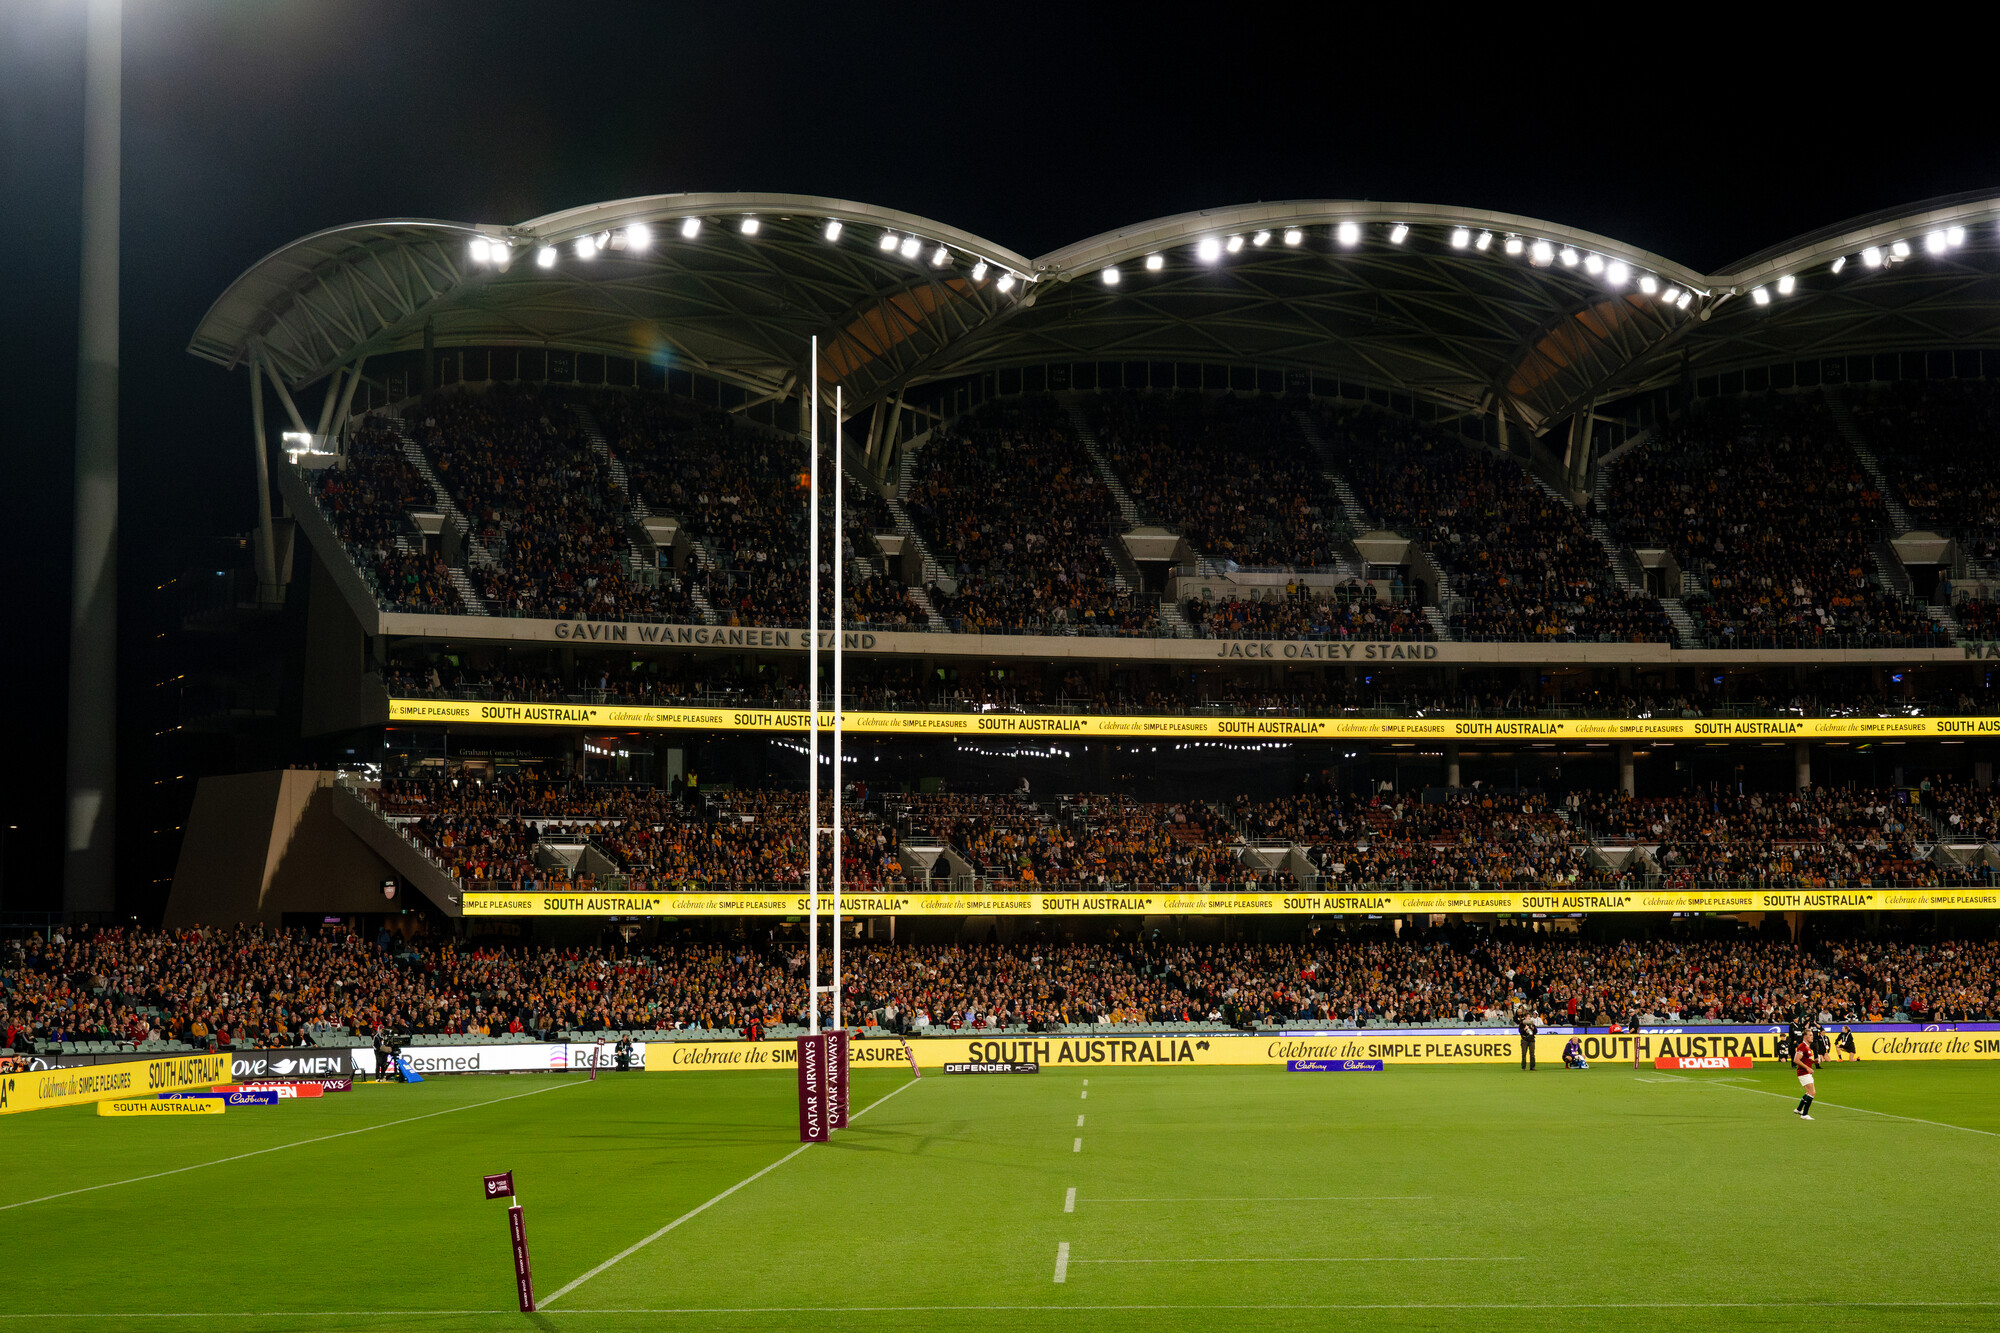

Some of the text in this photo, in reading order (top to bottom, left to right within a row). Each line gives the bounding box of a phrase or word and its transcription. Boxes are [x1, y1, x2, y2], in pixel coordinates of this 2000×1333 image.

[554, 622, 627, 641] GAVIN
[638, 625, 790, 647] WANGANEEN
[1217, 642, 1438, 660] JACK OATEY STAND
[400, 706, 426, 715] SIMPLE
[428, 707, 470, 716] PLEASURES
[482, 706, 589, 721] SOUTH AUSTRALIA
[609, 711, 723, 723] Celebrate the SIMPLE PLEASURES
[735, 713, 772, 726] SOUTH
[857, 717, 968, 728] Celebrate the SIMPLE PLEASURES
[978, 718, 1080, 731] SOUTH AUSTRALIA
[1099, 721, 1208, 731] Celebrate the SIMPLE PLEASURES
[1218, 721, 1318, 733] SOUTH AUSTRALIA
[1336, 723, 1445, 733] Celebrate the SIMPLE PLEASURES
[1456, 723, 1557, 734] SOUTH AUSTRALIA
[1575, 724, 1684, 733] Celebrate the SIMPLE PLEASURES
[1694, 722, 1796, 734] SOUTH AUSTRALIA
[1815, 723, 1848, 732] Celebrate
[1848, 722, 1860, 732] the
[1886, 723, 1926, 731] PLEASURES
[1937, 721, 1975, 732] SOUTH
[463, 900, 532, 909] SIMPLE PLEASURES
[544, 898, 652, 911] SOUTH AUSTRALIA
[672, 899, 787, 909] Celebrate the SIMPLE PLEASURES
[840, 898, 901, 911] AUSTRALIA
[921, 899, 1032, 909] Celebrate the SIMPLE PLEASURES
[1043, 898, 1145, 910] SOUTH AUSTRALIA
[1164, 899, 1273, 909] Celebrate the SIMPLE PLEASURES
[1284, 897, 1384, 909] SOUTH AUSTRALIA
[1403, 898, 1512, 907] Celebrate the SIMPLE PLEASURES
[1523, 896, 1624, 908] SOUTH AUSTRALIA
[1643, 897, 1674, 906] Celebrate
[1676, 897, 1687, 906] the
[1688, 898, 1712, 906] SIMPLE
[1764, 894, 1865, 907] SOUTH AUSTRALIA
[1885, 895, 1997, 904] Celebrate the SIMPLE PLEASURES
[968, 1040, 1195, 1063] SOUTH AUSTRALIA
[1267, 1041, 1512, 1058] Celebrate the SIMPLE PLEASURES
[1570, 1036, 1650, 1059] OUTH
[1659, 1036, 1779, 1059] AUSTRALI
[1872, 1037, 1942, 1054] Celebrate
[1946, 1037, 1970, 1053] the
[672, 1047, 742, 1064] Celebrate
[744, 1046, 767, 1063] the
[231, 1057, 341, 1076] ove MEN
[946, 1064, 1012, 1072] DEFENDER
[1295, 1060, 1376, 1071] Cadbury Cadbury
[1679, 1057, 1730, 1069] HOWDEN
[149, 1057, 219, 1089] SOUTH AUSTRALIA
[38, 1072, 131, 1099] Celebrate the SIMPLE PLEASURES
[828, 1035, 839, 1124] QATAR AIRWAYS
[805, 1041, 821, 1137] QATAR AIRWAYS
[229, 1092, 270, 1105] Cadbury
[113, 1103, 206, 1112] SOUTH AUSTRALIA
